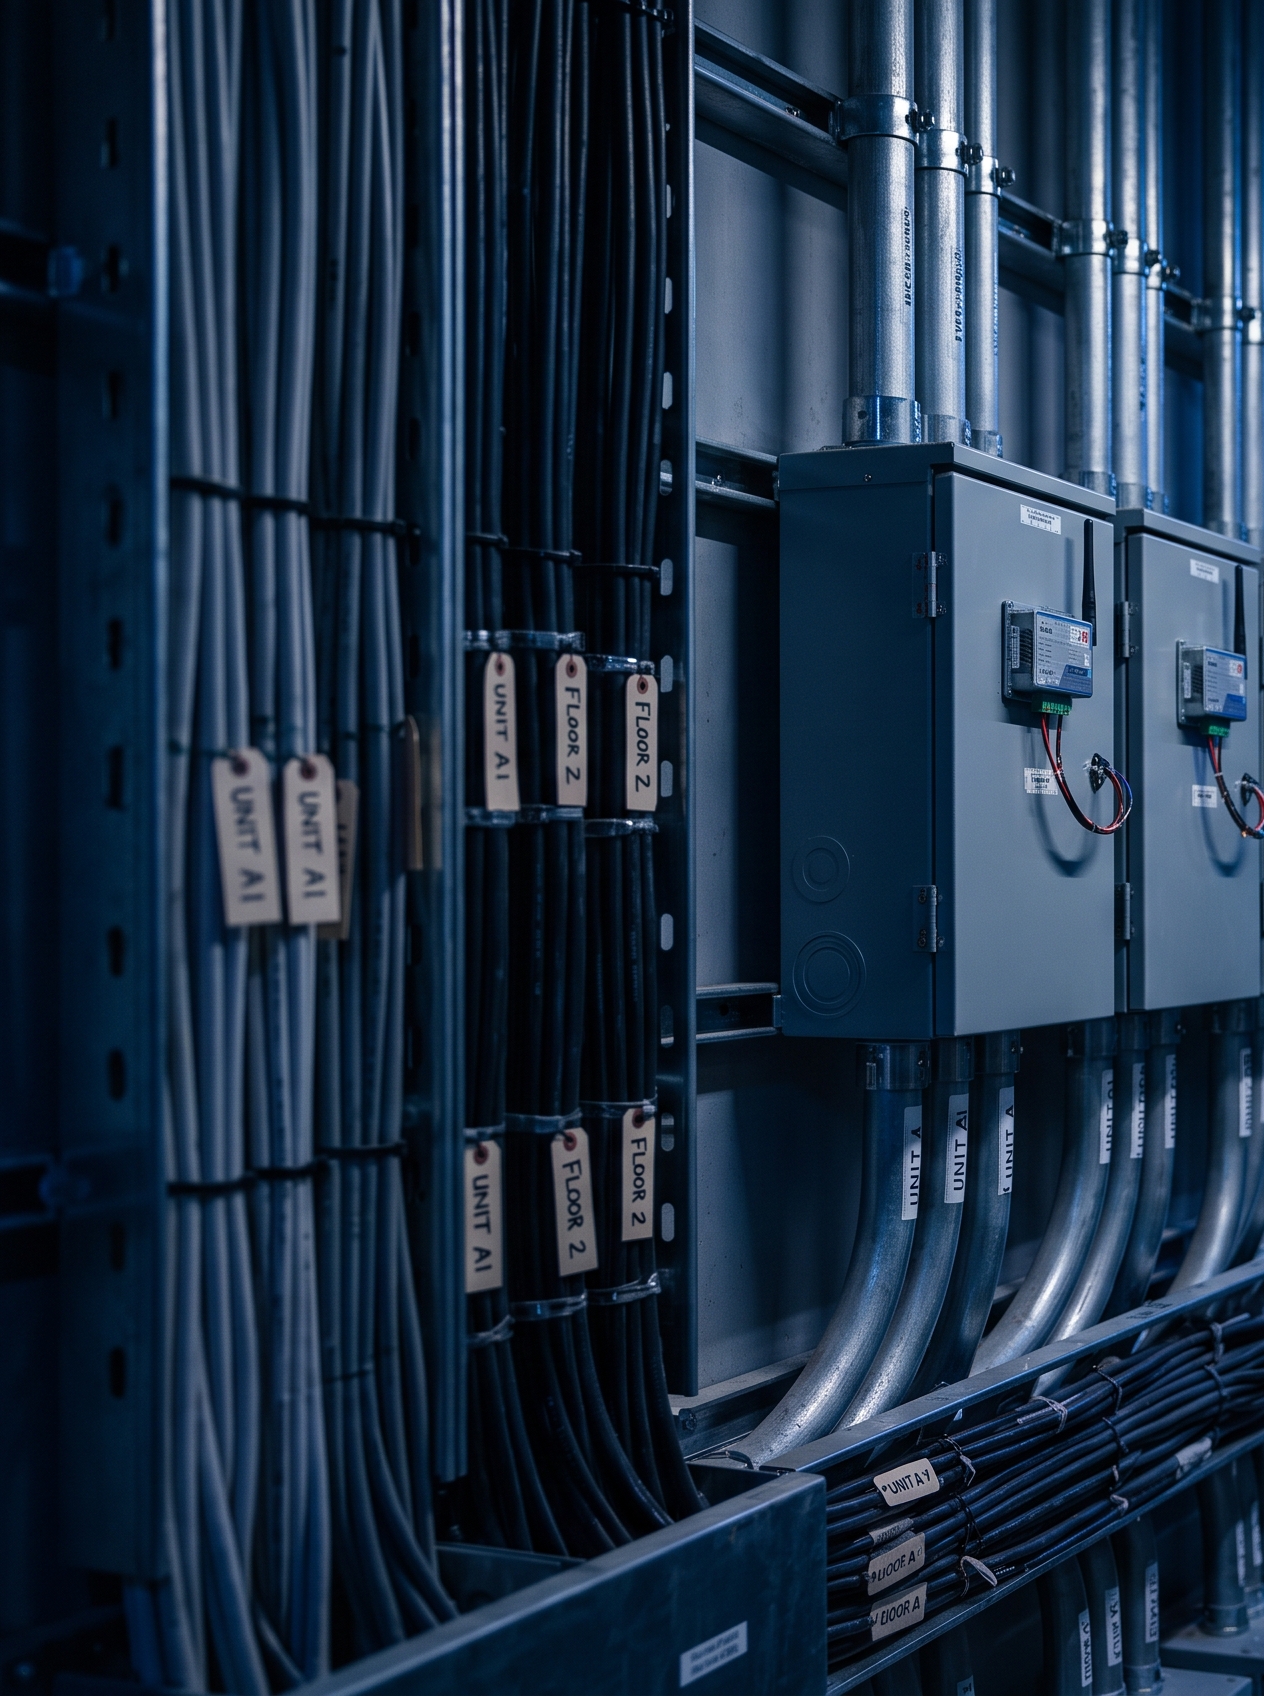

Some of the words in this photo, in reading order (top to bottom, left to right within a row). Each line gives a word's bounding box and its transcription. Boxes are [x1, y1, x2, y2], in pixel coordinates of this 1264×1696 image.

[494, 684, 510, 741] UNIT
[565, 687, 581, 757] FLOOR
[635, 702, 650, 766] FLOOR
[566, 766, 580, 784] 2
[635, 775, 650, 792] 2
[230, 786, 261, 853] UNIT
[298, 791, 323, 855] UNIT
[631, 1137, 647, 1203] FLOOR
[910, 1150, 920, 1206] UNIT
[953, 1138, 966, 1191] UNIT
[473, 1174, 491, 1234] UNIT
[562, 1159, 584, 1231] FLOOR
[632, 1212, 646, 1226] 2
[569, 1240, 586, 1259] 2
[887, 1474, 914, 1494] UNIT
[912, 1595, 920, 1612] A
